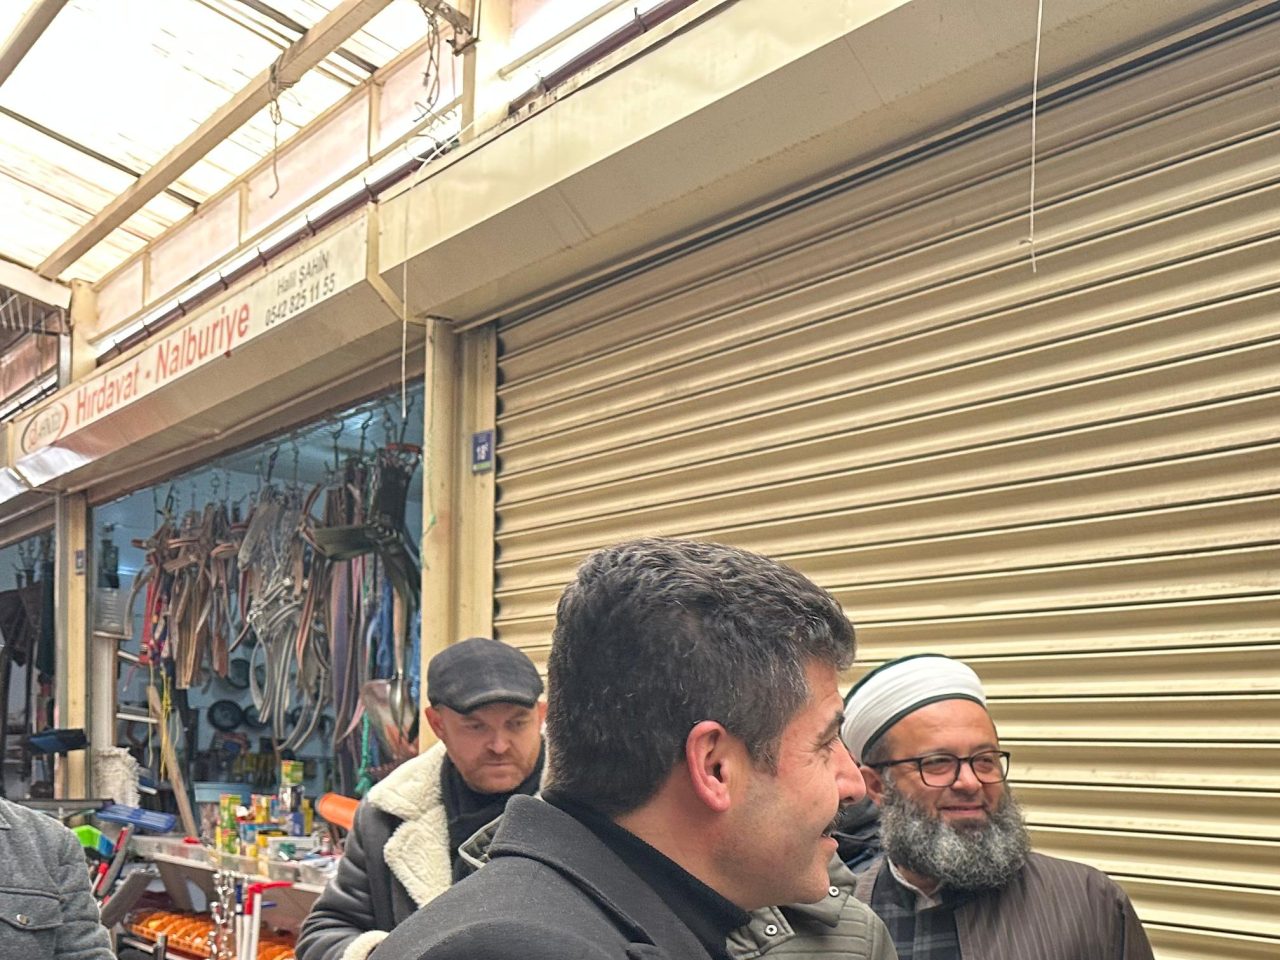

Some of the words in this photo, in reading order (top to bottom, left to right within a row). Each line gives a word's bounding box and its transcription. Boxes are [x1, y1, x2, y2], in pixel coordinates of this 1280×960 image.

[310, 280, 320, 303] 11
[323, 272, 336, 296] 55
[76, 361, 140, 425] Hırdavat
[155, 303, 250, 383] Nalburiye
